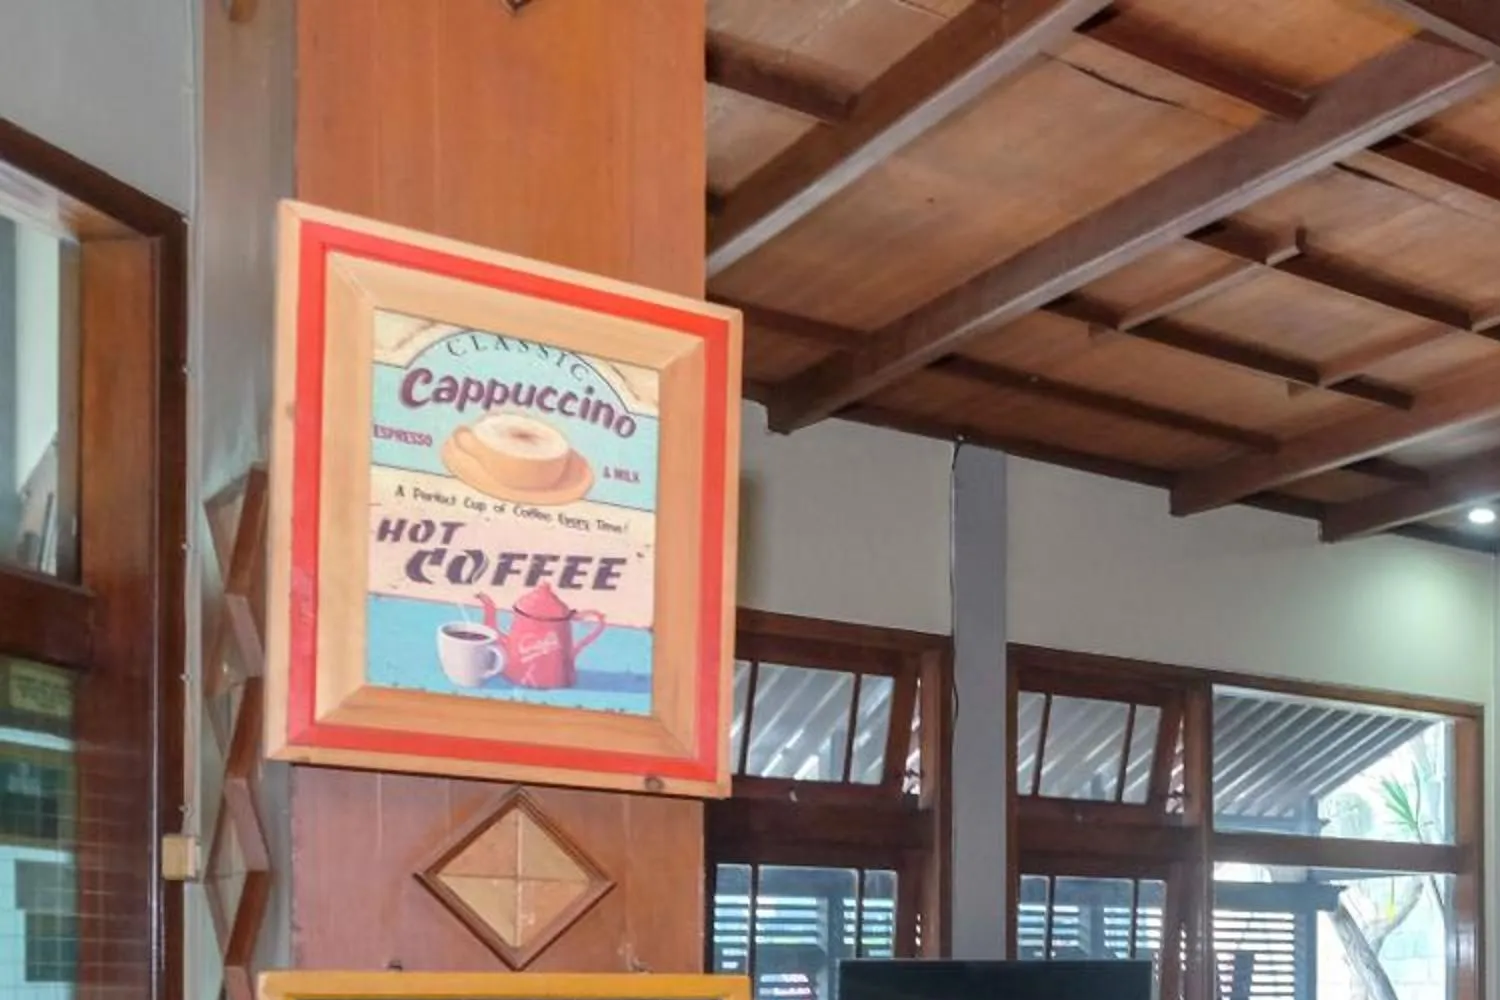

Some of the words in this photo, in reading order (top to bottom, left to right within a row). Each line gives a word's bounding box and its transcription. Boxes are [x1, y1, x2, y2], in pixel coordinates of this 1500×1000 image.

[446, 333, 590, 382] CLASSIC
[399, 367, 637, 439] Cappuccino
[373, 423, 433, 448] ESPRESSO
[395, 484, 405, 498] A
[464, 496, 487, 512] Cup
[493, 503, 506, 513] of
[513, 503, 552, 521] Coffee
[376, 516, 466, 545] HOT
[405, 547, 627, 591] COFFEE
